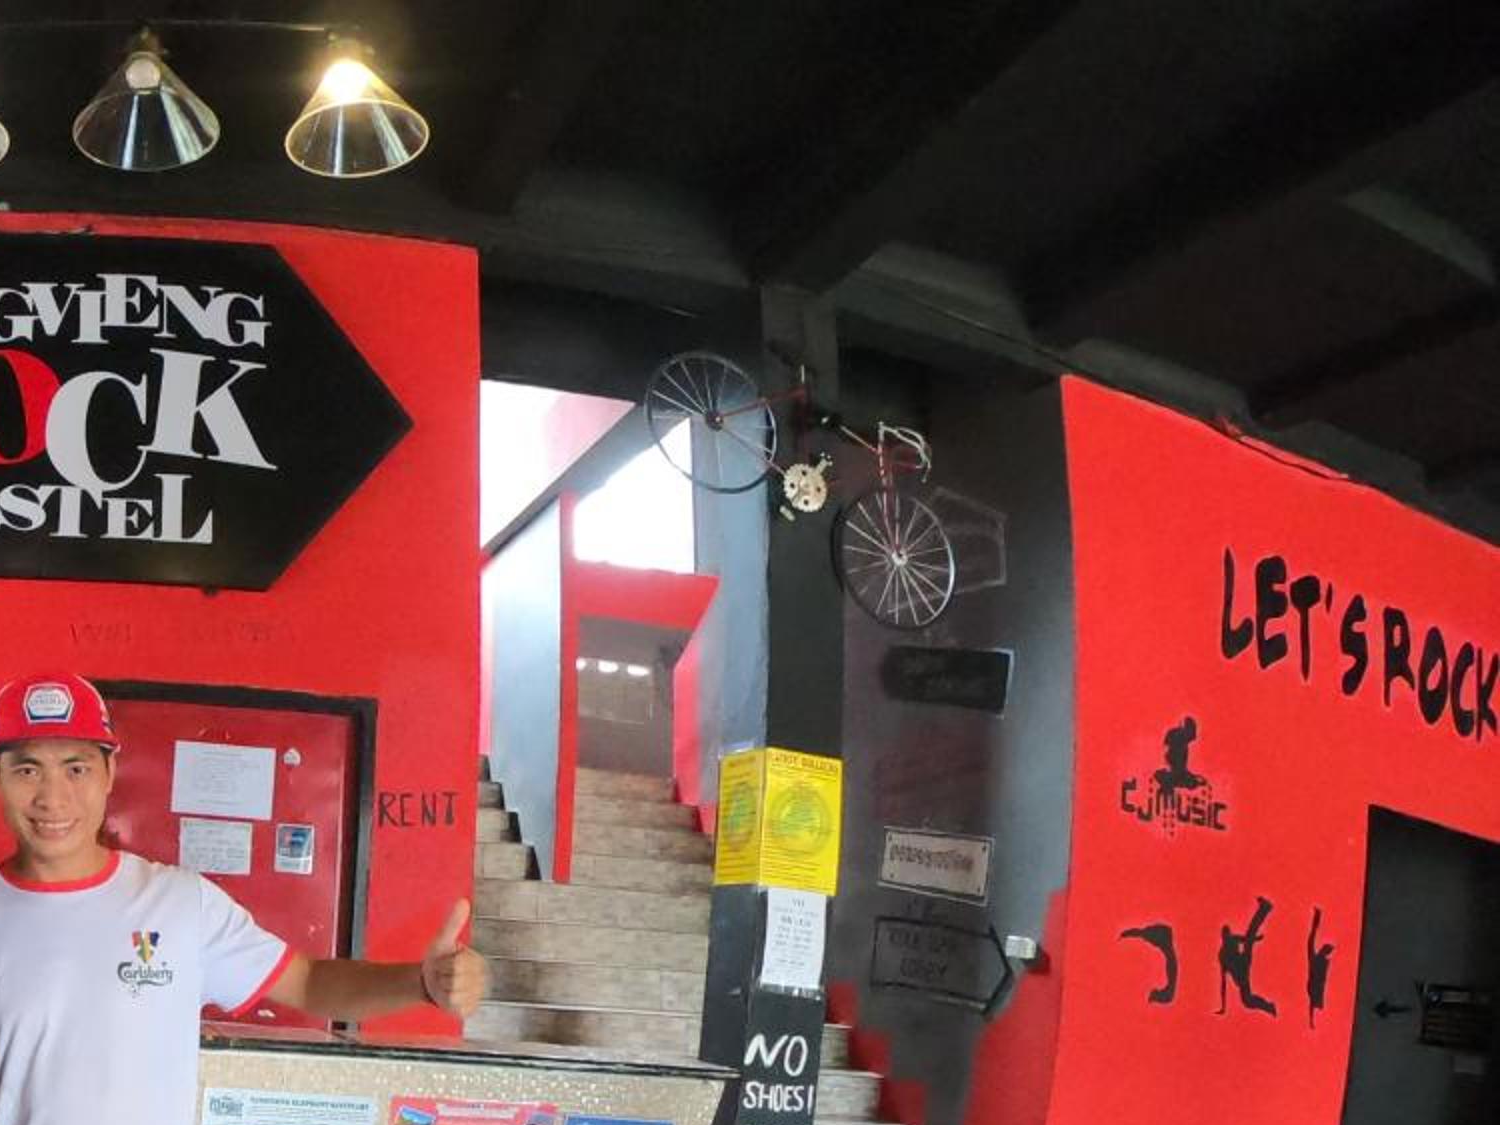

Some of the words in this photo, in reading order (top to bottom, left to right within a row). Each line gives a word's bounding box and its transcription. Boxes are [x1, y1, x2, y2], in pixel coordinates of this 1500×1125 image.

[1221, 546, 1369, 697] LET'S
[1382, 605, 1500, 745] ROCK
[377, 791, 458, 828] RENT
[116, 960, 174, 986] Carlsberg
[743, 1033, 809, 1077] NO
